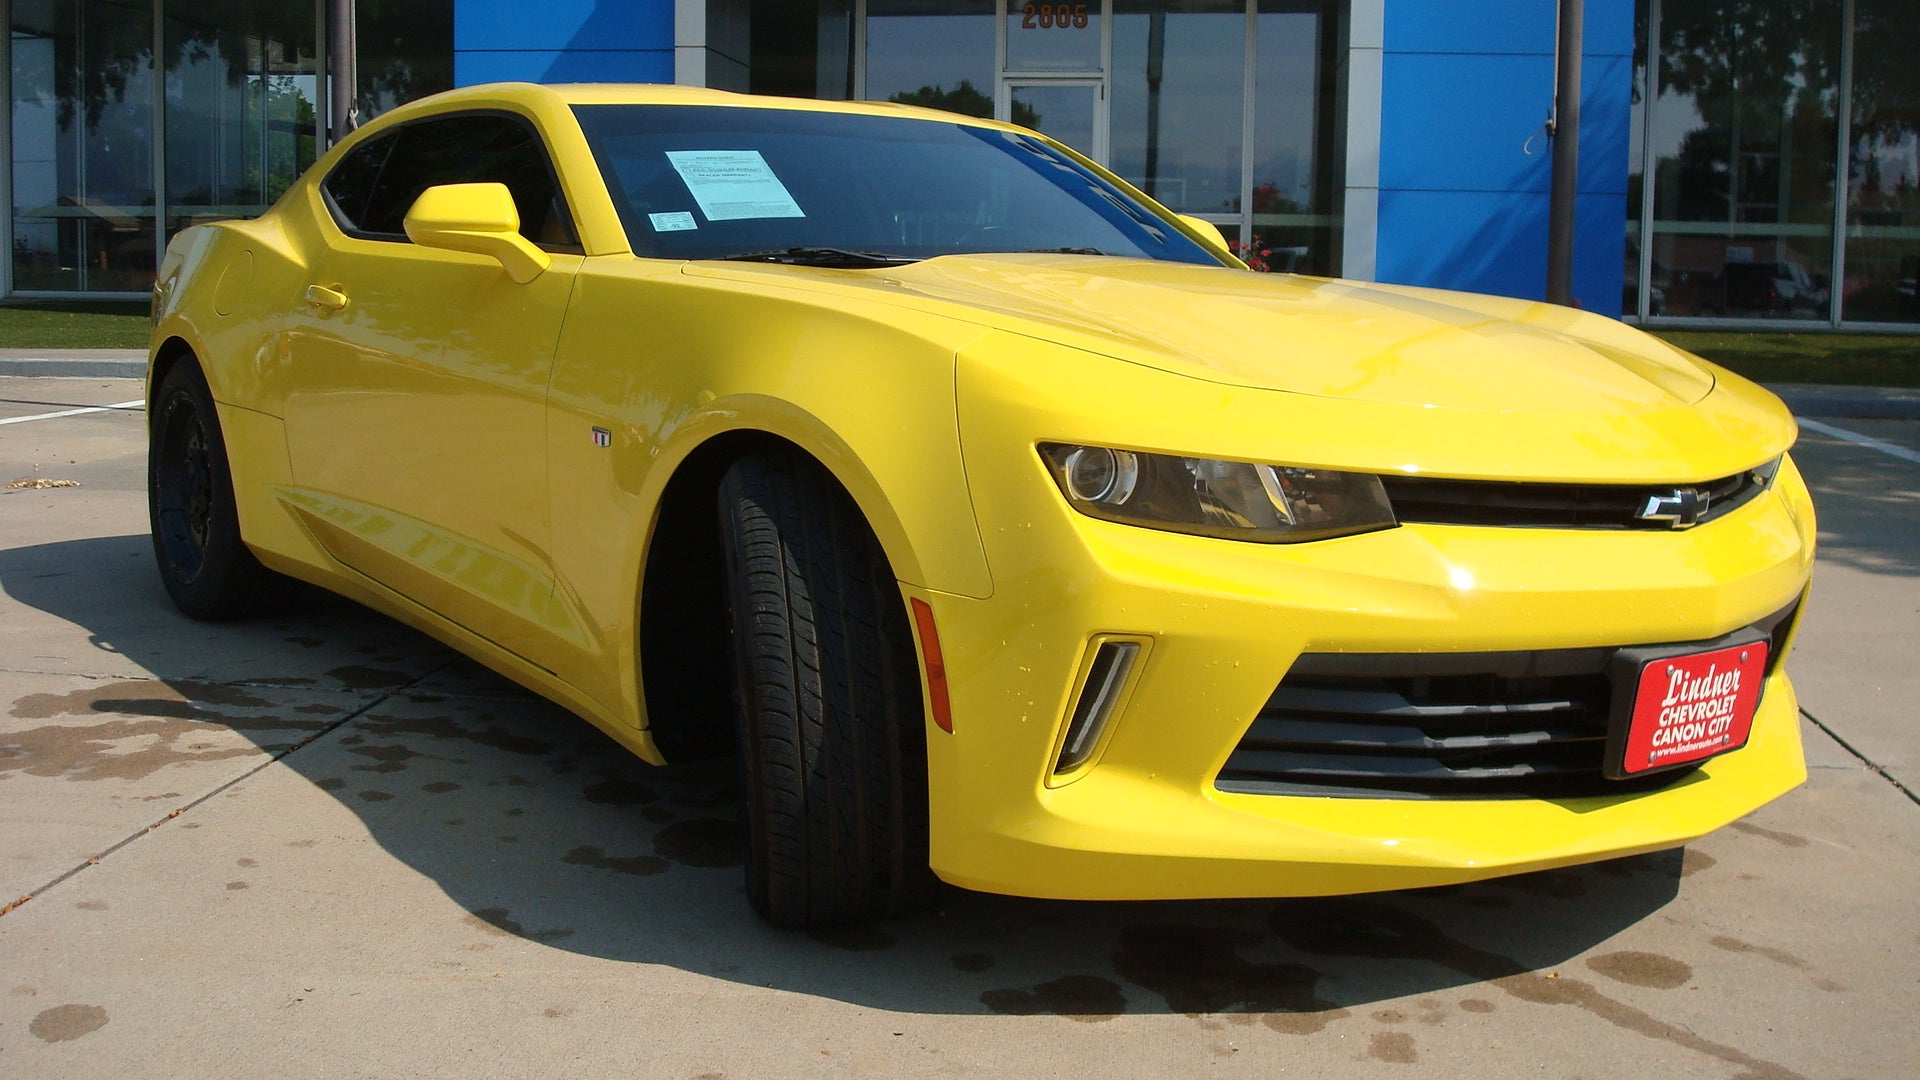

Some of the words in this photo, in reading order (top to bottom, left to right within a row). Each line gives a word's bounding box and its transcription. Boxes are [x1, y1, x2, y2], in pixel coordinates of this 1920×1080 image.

[1022, 3, 1088, 28] 2805
[1661, 663, 1741, 707] Lindner
[1658, 694, 1737, 727] CHEVROLET
[1652, 720, 1706, 747] CANON
[1708, 713, 1735, 738] CITY
[1656, 735, 1723, 757] www.lindnerauto.com
